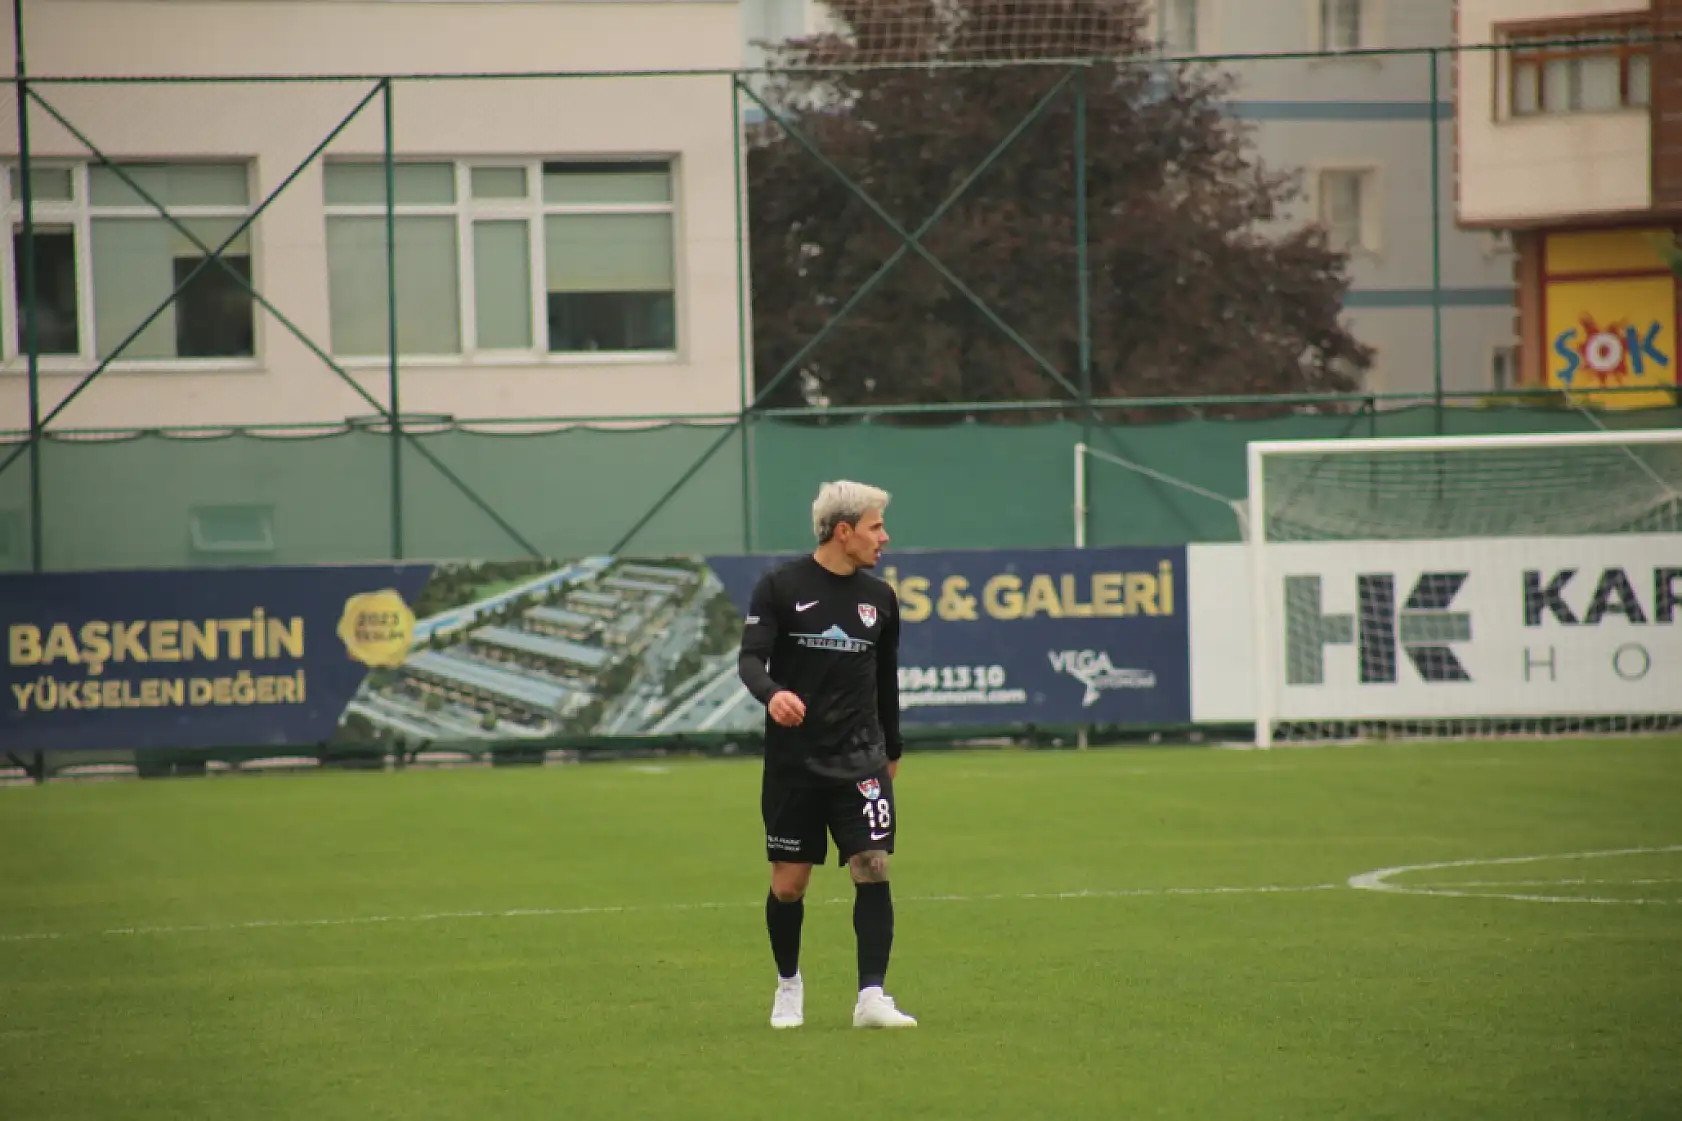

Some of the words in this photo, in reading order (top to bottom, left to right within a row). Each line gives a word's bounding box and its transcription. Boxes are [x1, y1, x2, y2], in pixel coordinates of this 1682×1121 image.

[937, 575, 979, 621] &
[983, 559, 1174, 620] GALERİ
[9, 606, 304, 675] BAŞKENTİN
[11, 675, 185, 712] YÜKSELEN
[189, 669, 305, 706] DEĞERİ
[974, 665, 1005, 689] 10
[862, 798, 890, 828] 18
